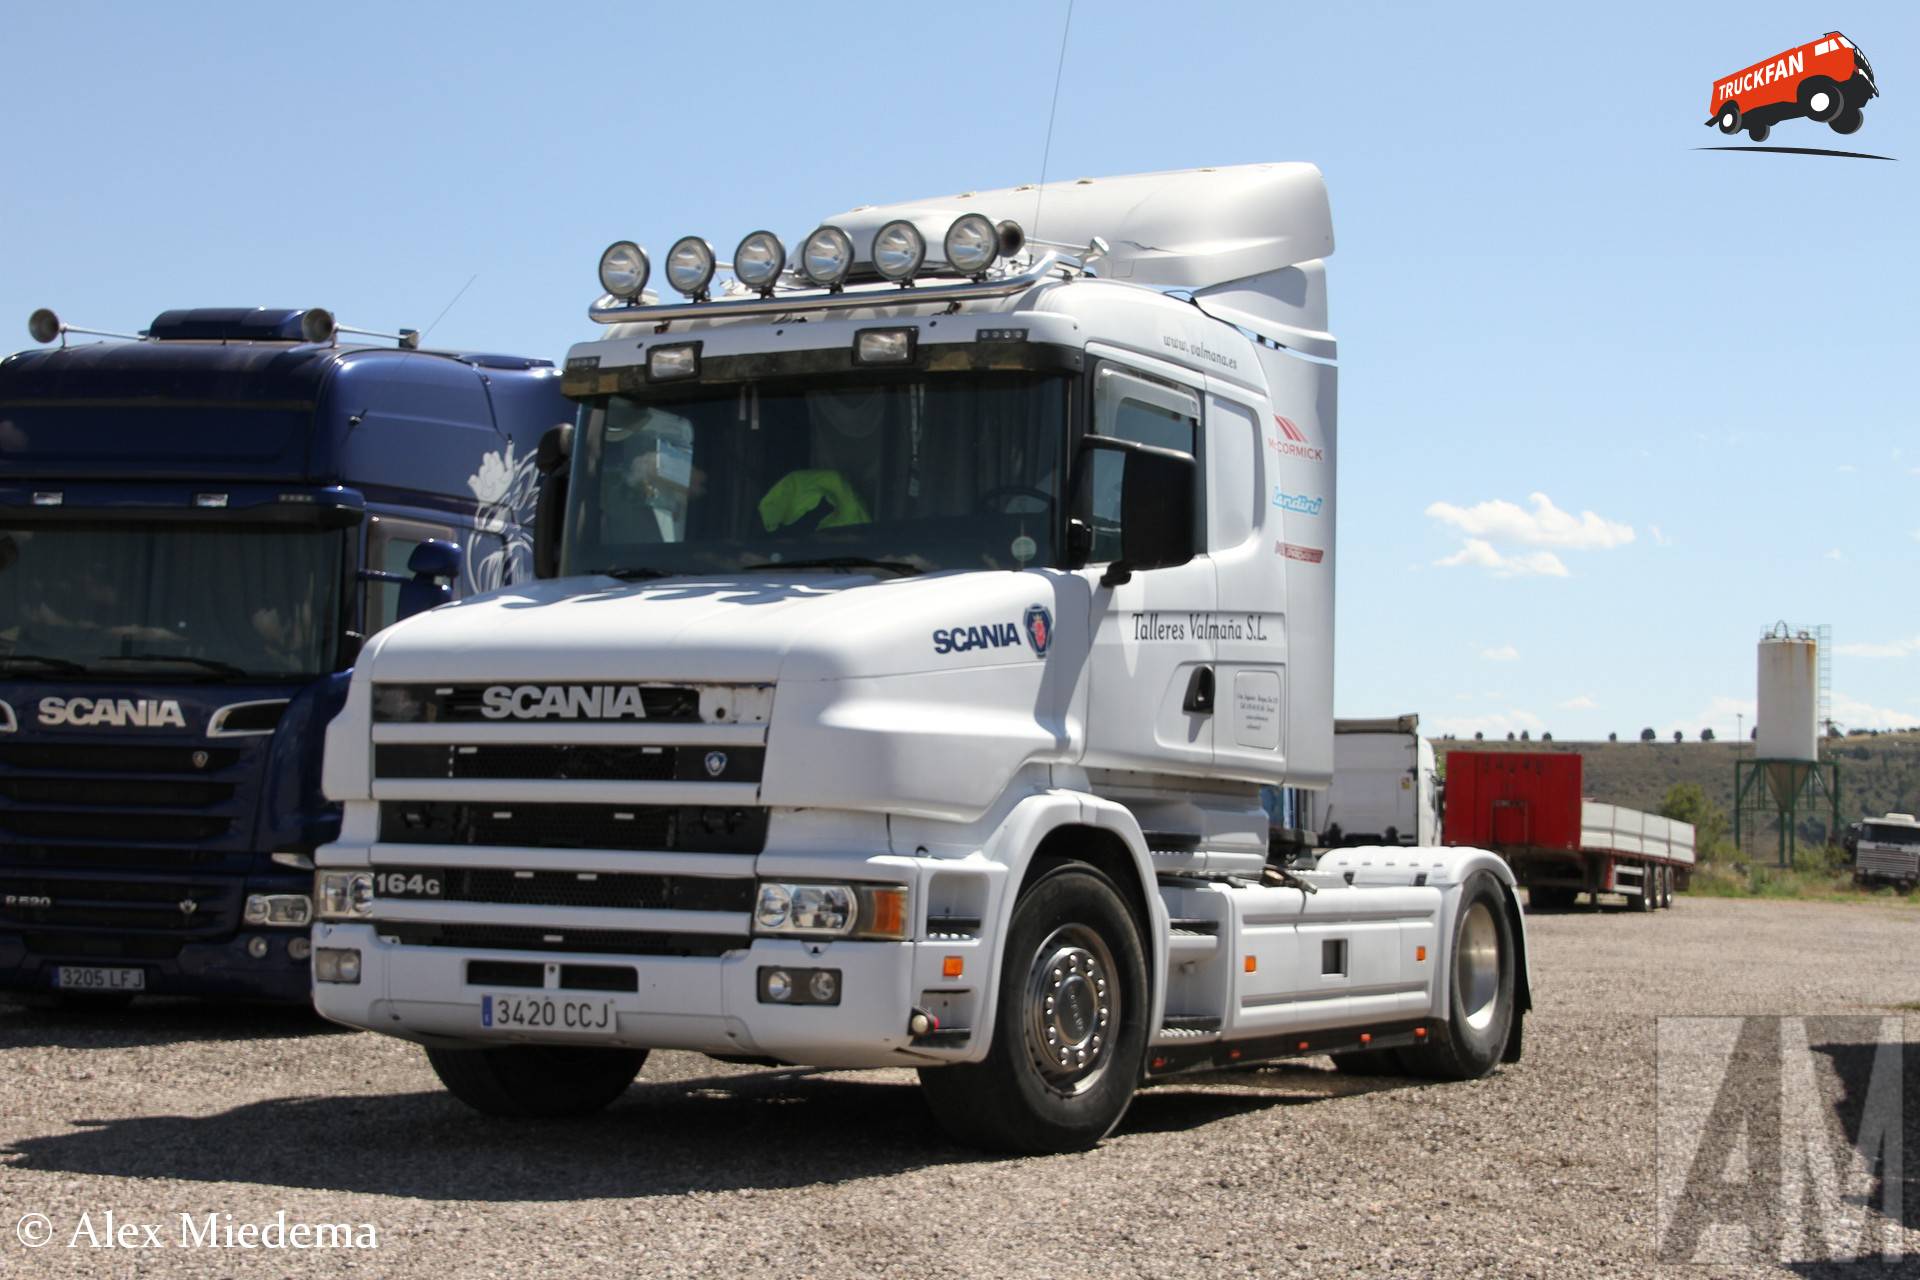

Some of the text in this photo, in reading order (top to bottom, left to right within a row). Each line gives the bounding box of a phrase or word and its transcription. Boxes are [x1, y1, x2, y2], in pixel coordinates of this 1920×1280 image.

[932, 622, 1022, 655] SCANIA
[1132, 612, 1267, 641] Talleres Valmaña S.L.
[37, 696, 186, 728] SCANIA
[480, 685, 646, 719] SCANIA
[376, 873, 441, 895] 164G
[62, 967, 143, 988] 3205 LFJ
[497, 1000, 609, 1029] 3420 CCJ
